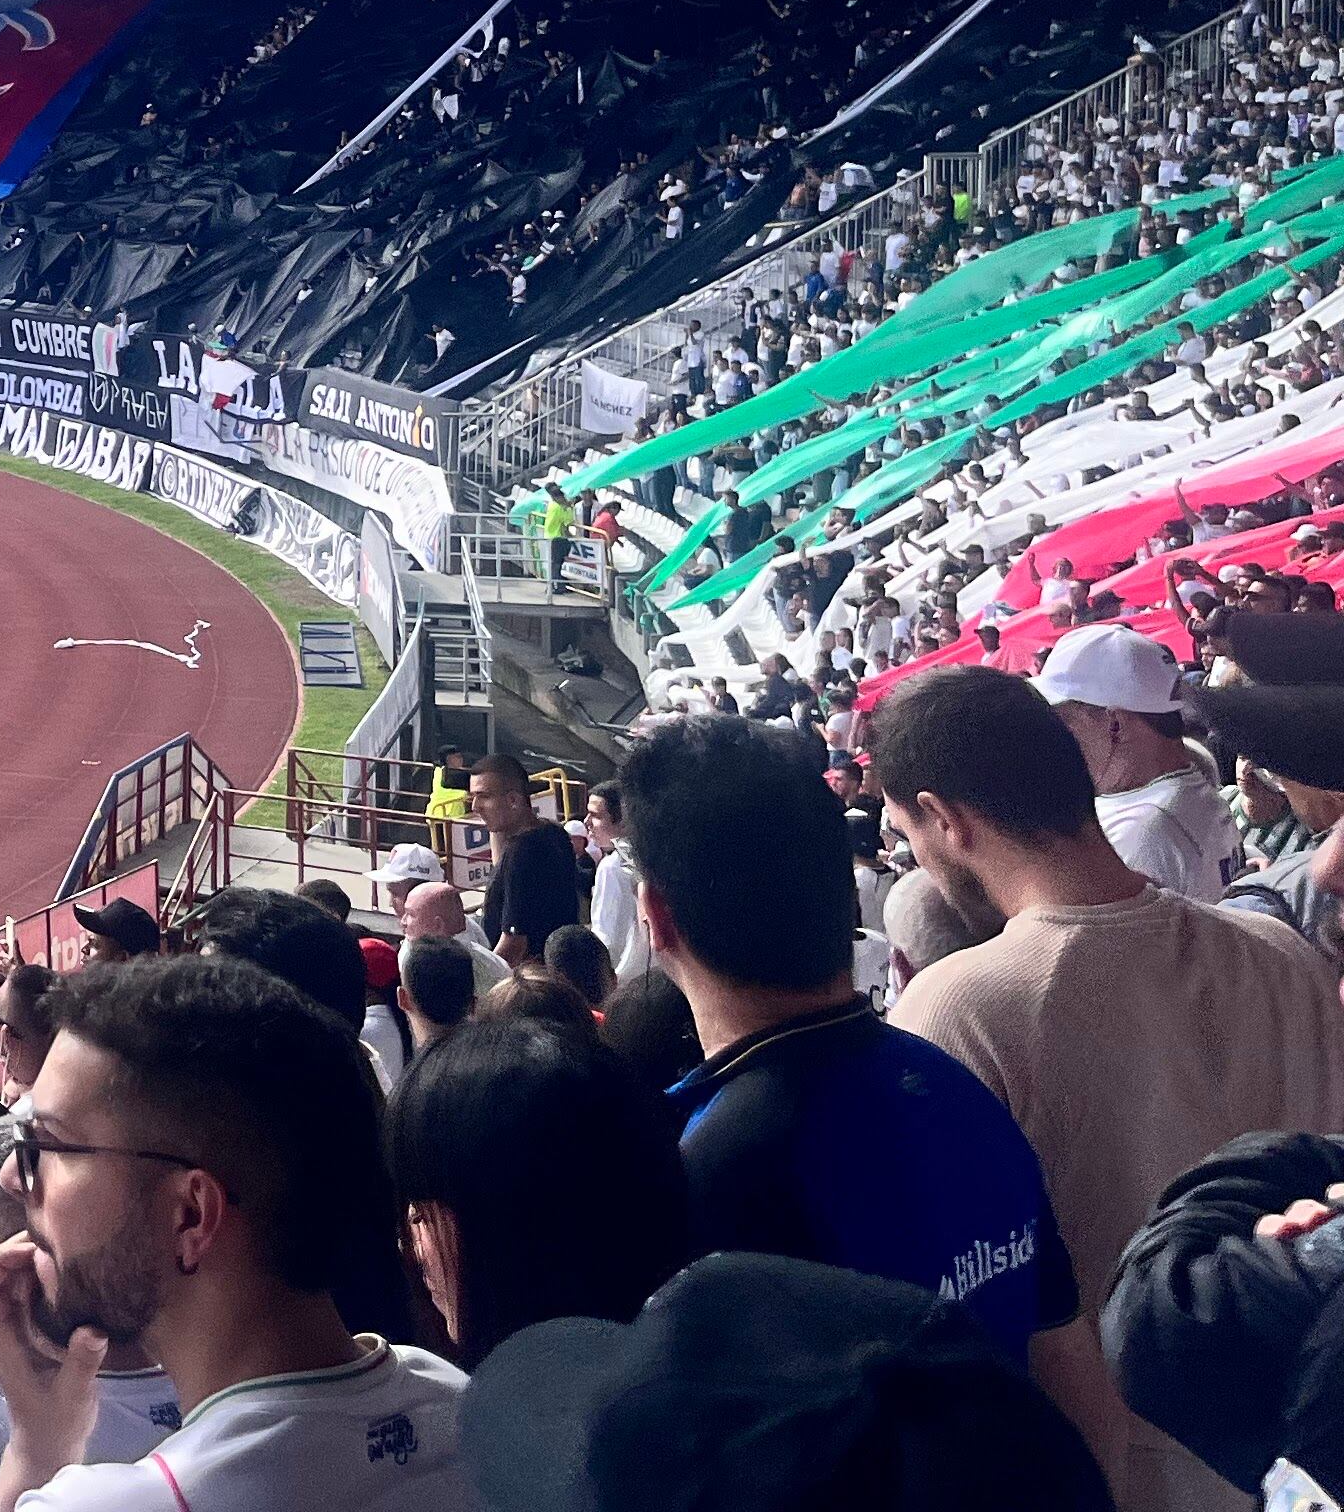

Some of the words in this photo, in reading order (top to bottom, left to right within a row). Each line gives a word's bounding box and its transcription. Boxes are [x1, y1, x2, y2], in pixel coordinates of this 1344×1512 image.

[12, 318, 92, 361] CUMBRE
[152, 340, 198, 395] LA
[355, 397, 435, 451] ANTONIO
[468, 866, 482, 882] DE
